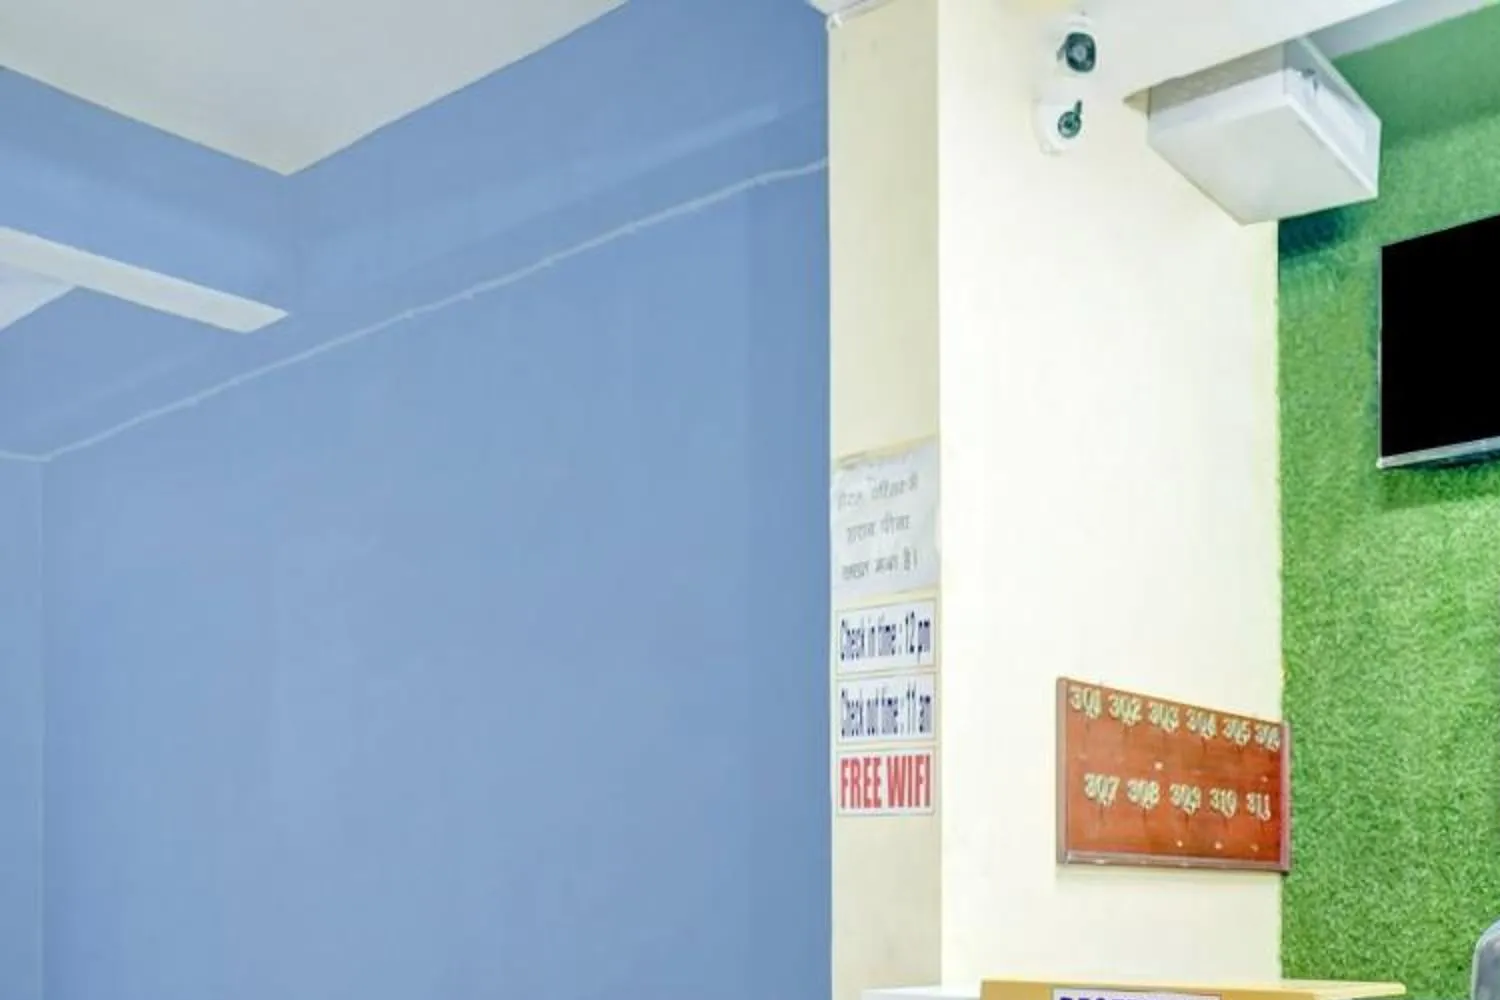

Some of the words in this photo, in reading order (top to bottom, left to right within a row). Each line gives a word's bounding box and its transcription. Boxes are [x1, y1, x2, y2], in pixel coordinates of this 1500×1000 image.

[840, 617, 865, 661] Check
[867, 616, 875, 656] in
[877, 612, 896, 656] time
[904, 611, 915, 655] 12
[917, 618, 930, 664] pm
[840, 686, 865, 736] Check
[866, 686, 879, 735] out
[881, 686, 899, 734] time
[906, 681, 917, 733] 11
[919, 693, 933, 734] am
[1108, 693, 1142, 727] 302
[840, 757, 882, 809] FREE
[886, 754, 931, 808] WIFI
[1084, 772, 1121, 808] 307
[1127, 778, 1161, 809] 308
[1208, 787, 1238, 819] 310
